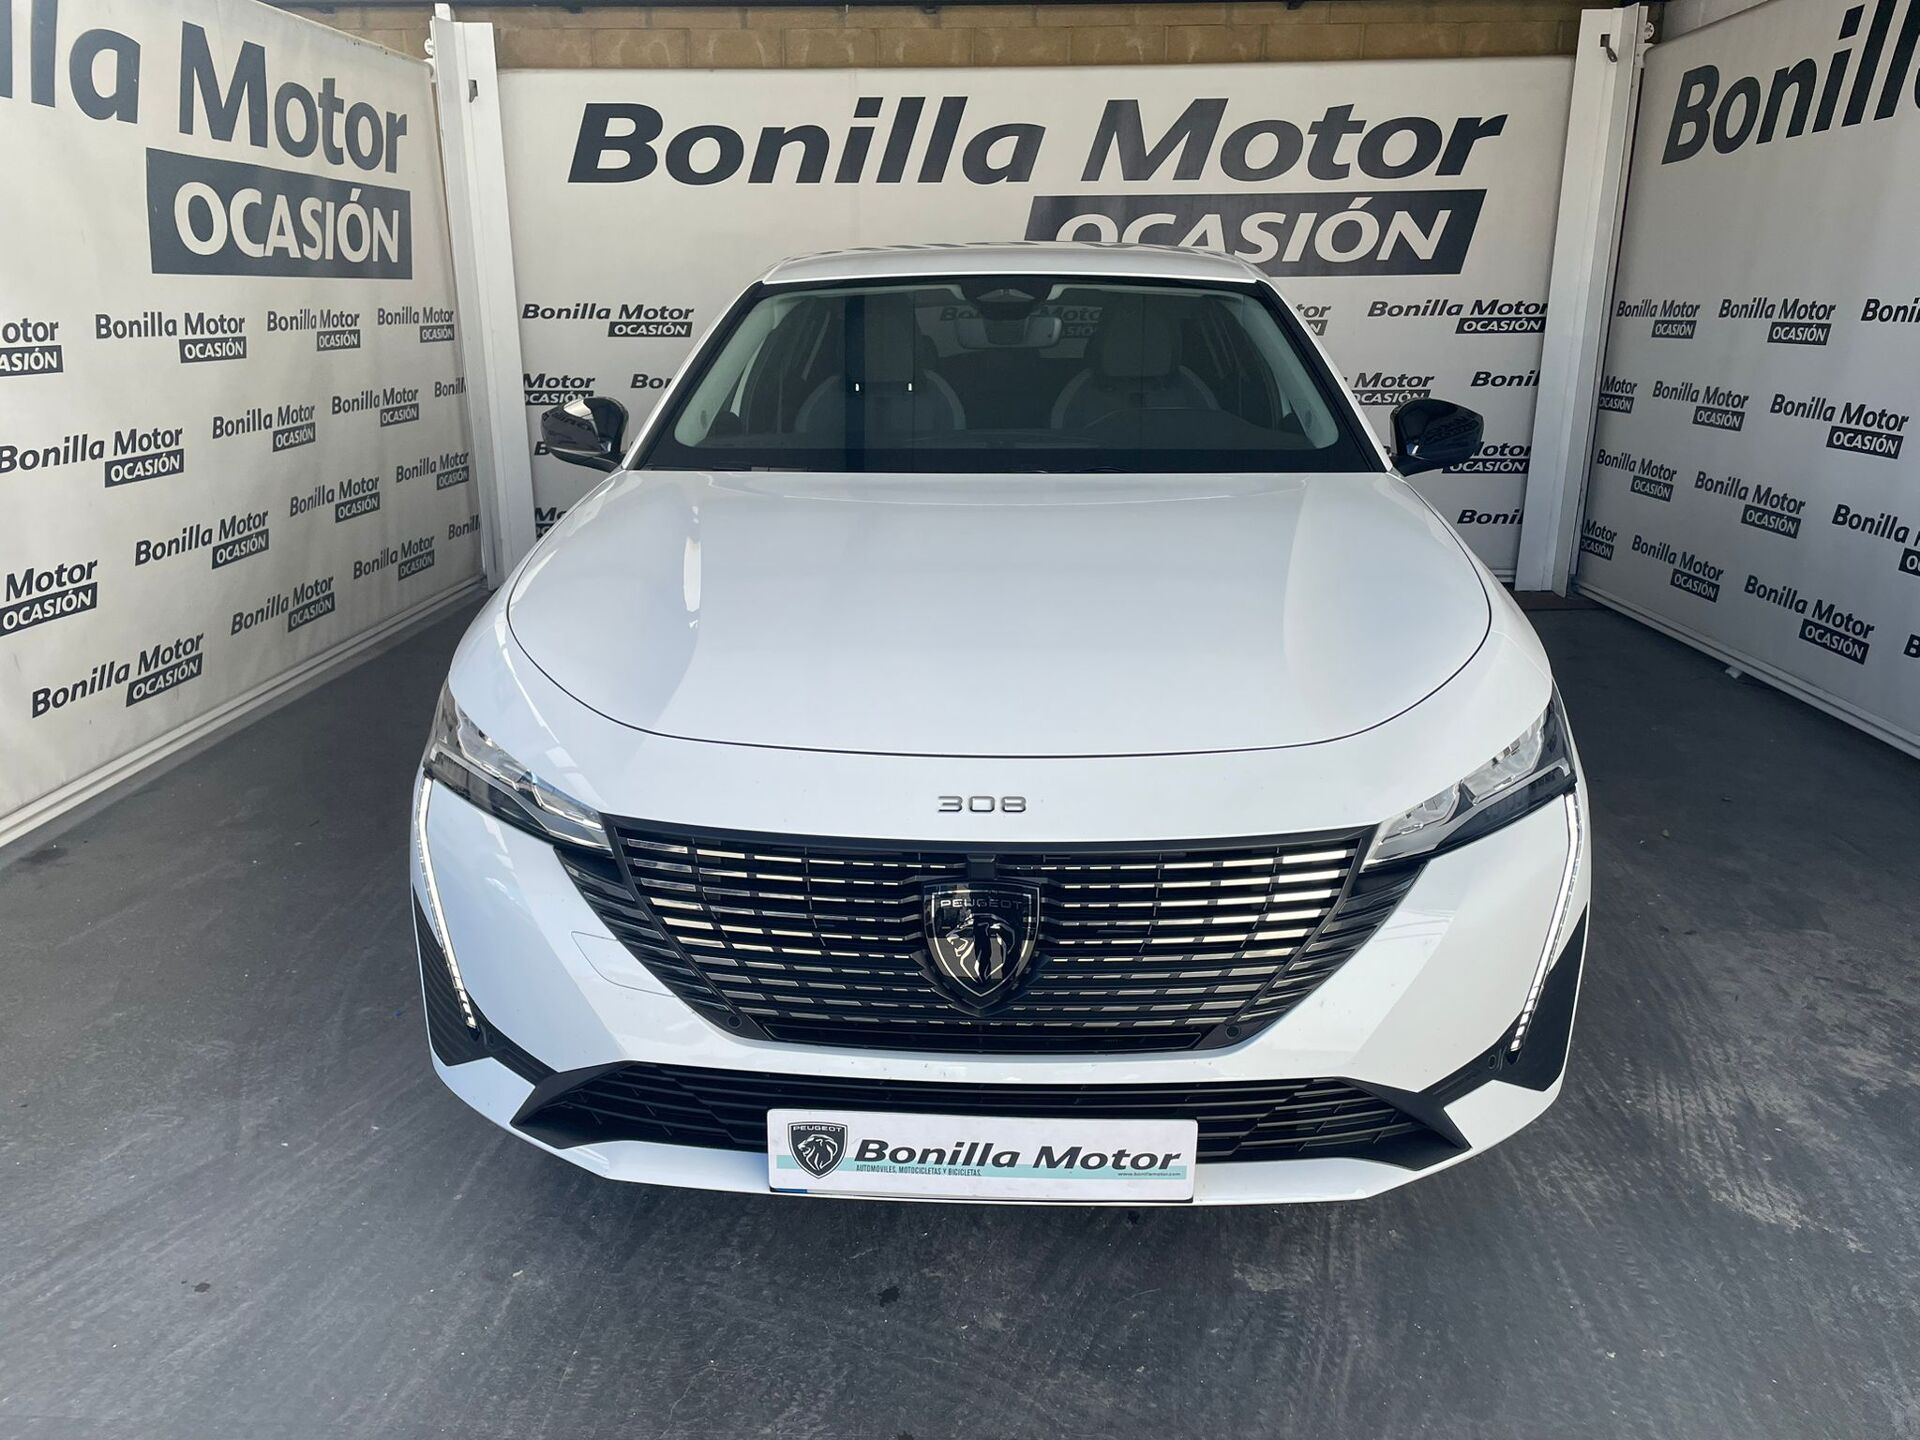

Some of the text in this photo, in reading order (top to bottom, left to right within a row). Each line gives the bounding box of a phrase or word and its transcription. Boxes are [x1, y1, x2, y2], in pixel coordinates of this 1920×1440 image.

[1661, 0, 1920, 165] Bonill
[179, 20, 407, 173] Motor
[568, 96, 1508, 185] Bonilla Motor
[174, 181, 399, 264] OCASIÓN
[267, 309, 360, 332] Bonilla Motor
[377, 307, 454, 326] Bonilla Motor
[522, 303, 695, 320] Bonilla Motor
[1368, 299, 1548, 317] Bonilla Motor
[1616, 299, 1700, 318] Bonilla Motor
[1718, 297, 1836, 320] Bonilla Motor
[1861, 297, 1920, 322] Boni
[2, 318, 59, 343] otor
[95, 312, 246, 340] Bonilla Motor
[422, 326, 453, 341] OCASIÓN
[614, 323, 687, 335] OCASIÓN
[1464, 318, 1542, 332] OCASIÓN
[1655, 321, 1694, 337] OCASIÓN
[1772, 323, 1827, 342] OCASIÓN
[184, 340, 244, 358] OCASIÓN
[319, 332, 358, 348] OCASIÓN
[0, 348, 57, 371] ASIÓN
[523, 374, 595, 389] Motor
[1354, 372, 1435, 388] Motor
[1602, 376, 1638, 395] Motor
[332, 386, 418, 415] Bonilla Motor
[1652, 380, 1749, 409] Bonilla Motor
[212, 403, 315, 439] Bonilla Motor
[382, 406, 417, 424] OCASIÓN
[1697, 407, 1743, 428] OCASIÓN
[1770, 393, 1909, 432] Bonilla Motor
[275, 424, 314, 449] OCASIÓN
[1833, 428, 1899, 455] OCASIÓN
[0, 428, 183, 474] Bonilla Motor
[110, 453, 180, 482] OCASIÓN
[396, 452, 469, 482] Bonilla Motor
[439, 469, 467, 487] OCASIÓN
[1596, 449, 1677, 481] Bonilla Motor
[290, 475, 380, 517] Bonilla Motor
[1633, 480, 1672, 498] OCASIÓN
[1695, 471, 1806, 515] Bonilla Motor
[337, 495, 379, 520] OCASIÓN
[1746, 507, 1797, 535] OCASIÓN
[1583, 520, 1617, 542] Motor
[1832, 504, 1910, 543] Bonilla
[135, 511, 269, 566] Bonilla Motor
[216, 533, 267, 565] OCASIÓN
[354, 535, 435, 580] Bonilla Motor
[400, 551, 434, 579] OCASIÓN
[1632, 535, 1724, 581] Bonilla Motor
[6, 559, 98, 602] Motor
[1674, 572, 1718, 598] OCASIÓN
[3, 589, 92, 630] OCASIÓN
[231, 577, 334, 636] Bonilla Motor
[289, 597, 332, 628] OCASIÓN
[1744, 574, 1875, 639] Bonilla Motor
[1805, 624, 1866, 660] OCASIÓN
[32, 633, 203, 718] Bonilla Motor
[133, 659, 200, 699] OCASIÓN
[938, 796, 1027, 813] 308
[940, 898, 1024, 909] PEUGEOT
[792, 1125, 843, 1133] PEUGEOT
[854, 1139, 1181, 1170] Bonilla Motor
[899, 1166, 942, 1175] MOTOCICLETAS
